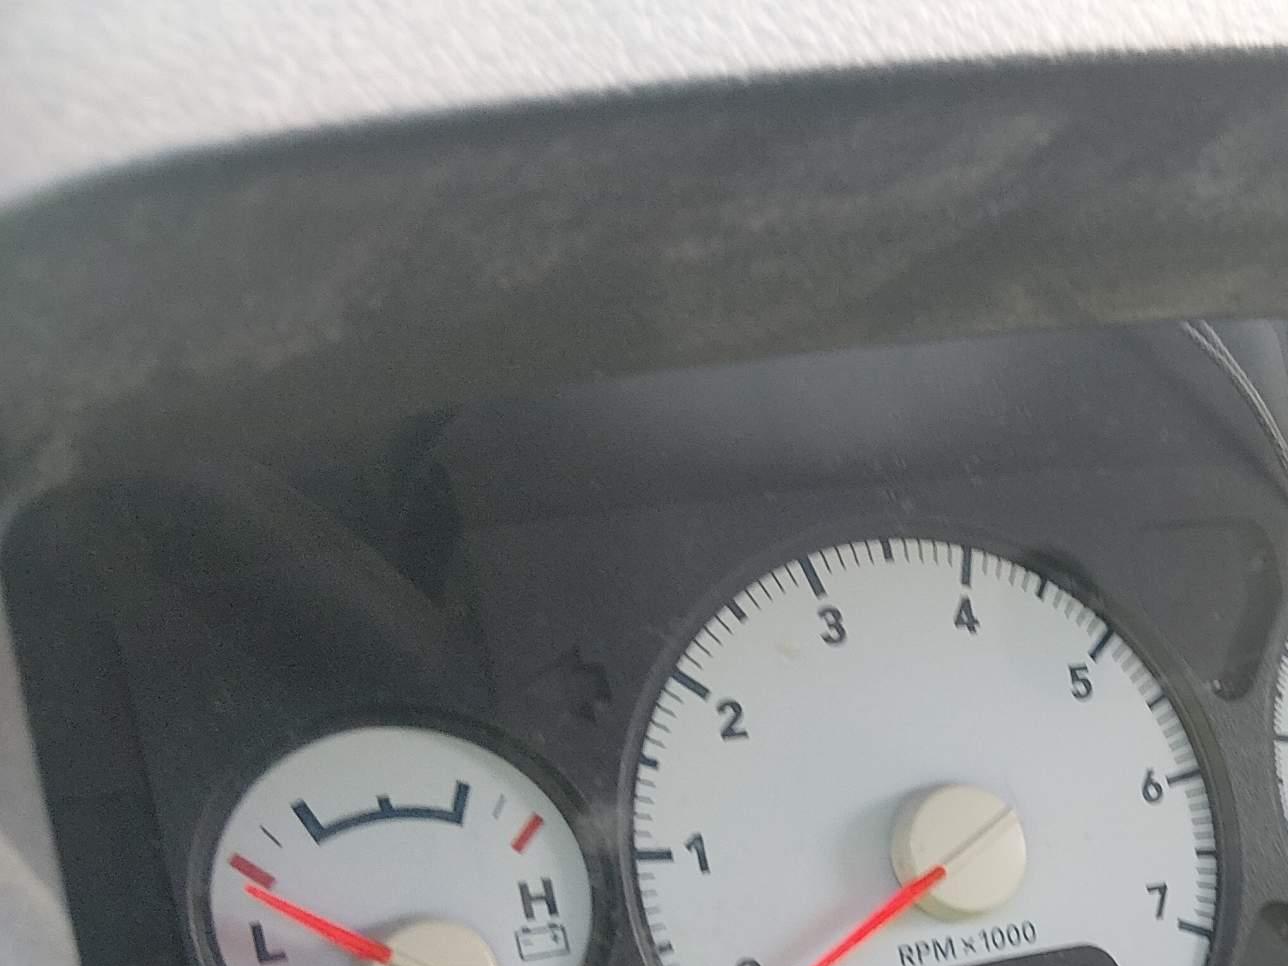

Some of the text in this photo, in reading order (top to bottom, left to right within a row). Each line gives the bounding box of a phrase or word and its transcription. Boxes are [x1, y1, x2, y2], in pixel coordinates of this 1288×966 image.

[818, 606, 847, 645] 3
[954, 596, 981, 635] 4
[1068, 663, 1093, 700] 5
[716, 700, 749, 740] 2
[1142, 768, 1164, 803] 6
[685, 833, 710, 874] 1
[518, 876, 559, 920] H
[1145, 882, 1170, 920] 7
[249, 920, 288, 966] L
